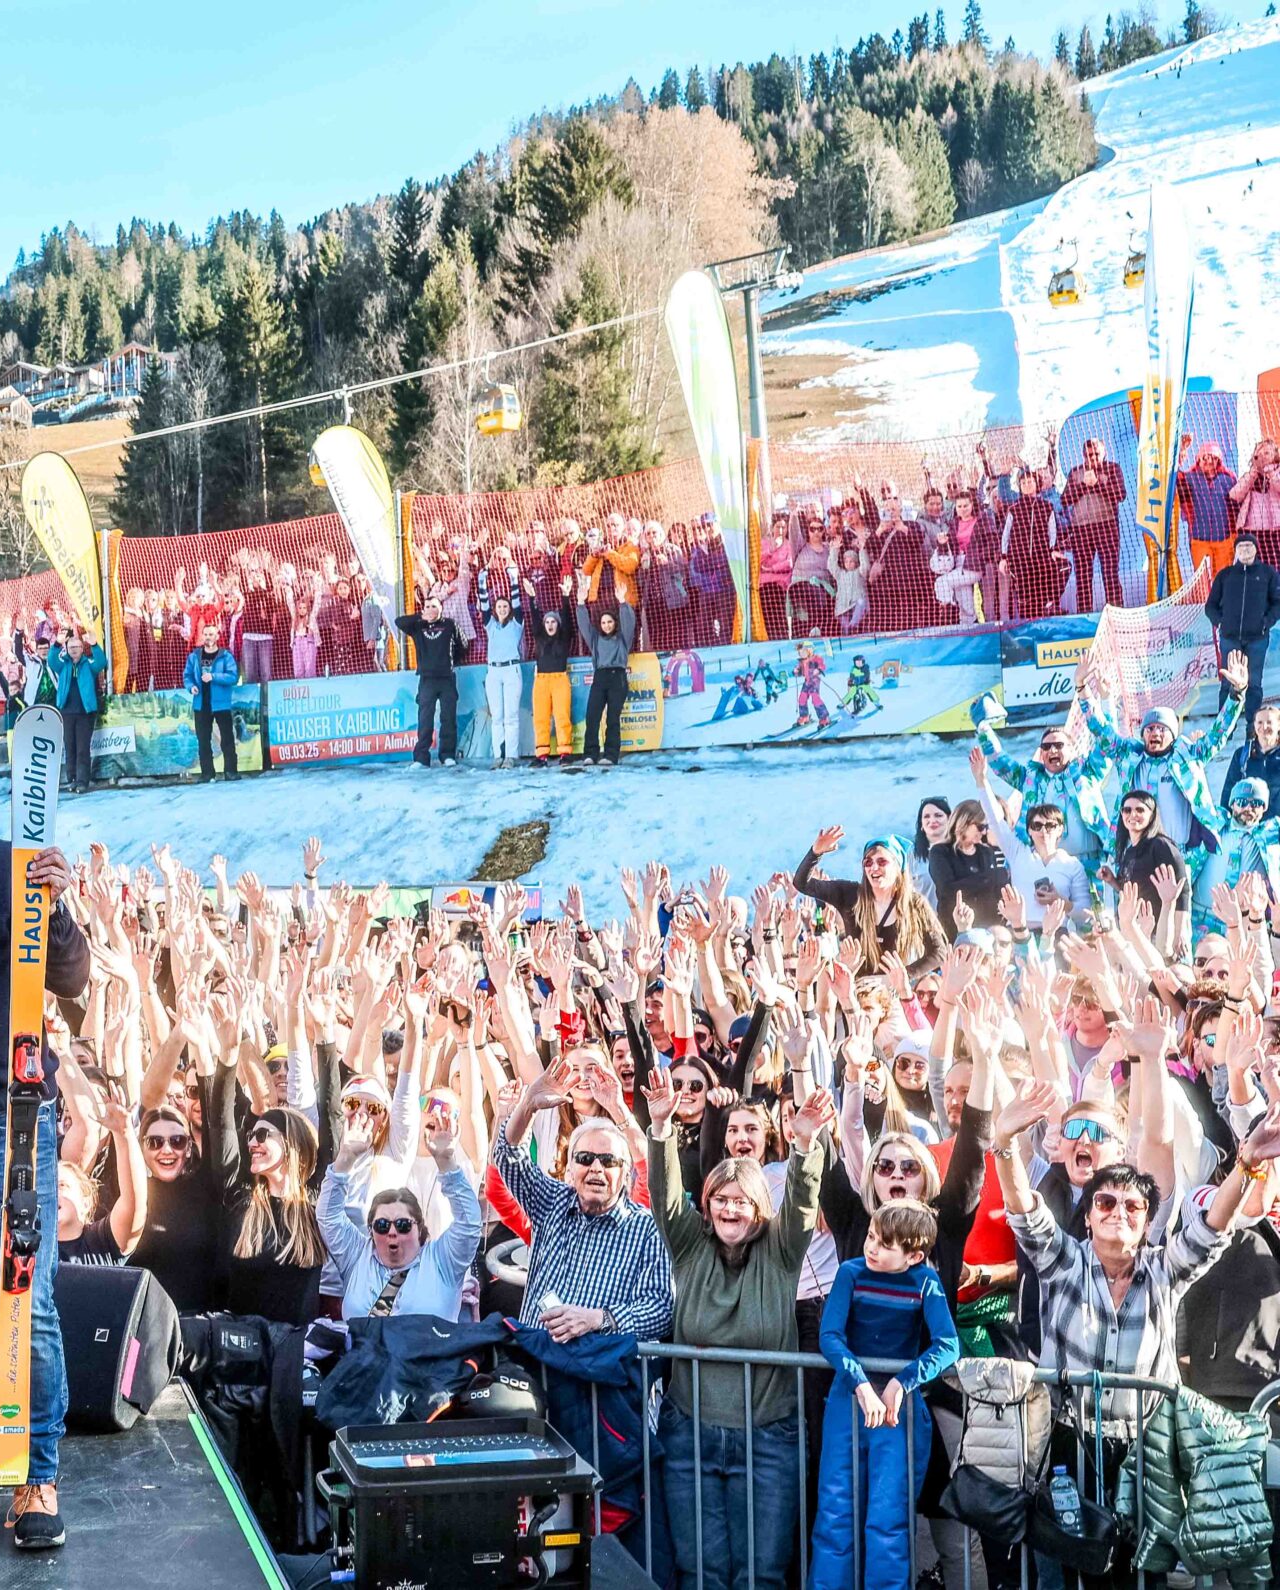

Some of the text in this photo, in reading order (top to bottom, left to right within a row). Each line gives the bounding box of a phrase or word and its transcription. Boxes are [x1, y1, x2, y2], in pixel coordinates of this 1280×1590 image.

[1043, 647, 1087, 660] HAUS
[275, 694, 342, 715] GIPFELTOUR
[276, 709, 400, 742] HAUSER KAIBLING
[621, 715, 656, 723] TENLOSES
[279, 734, 418, 761] 09.03.25 14:00 Uhr AlmAre
[23, 735, 55, 843] Kaibling
